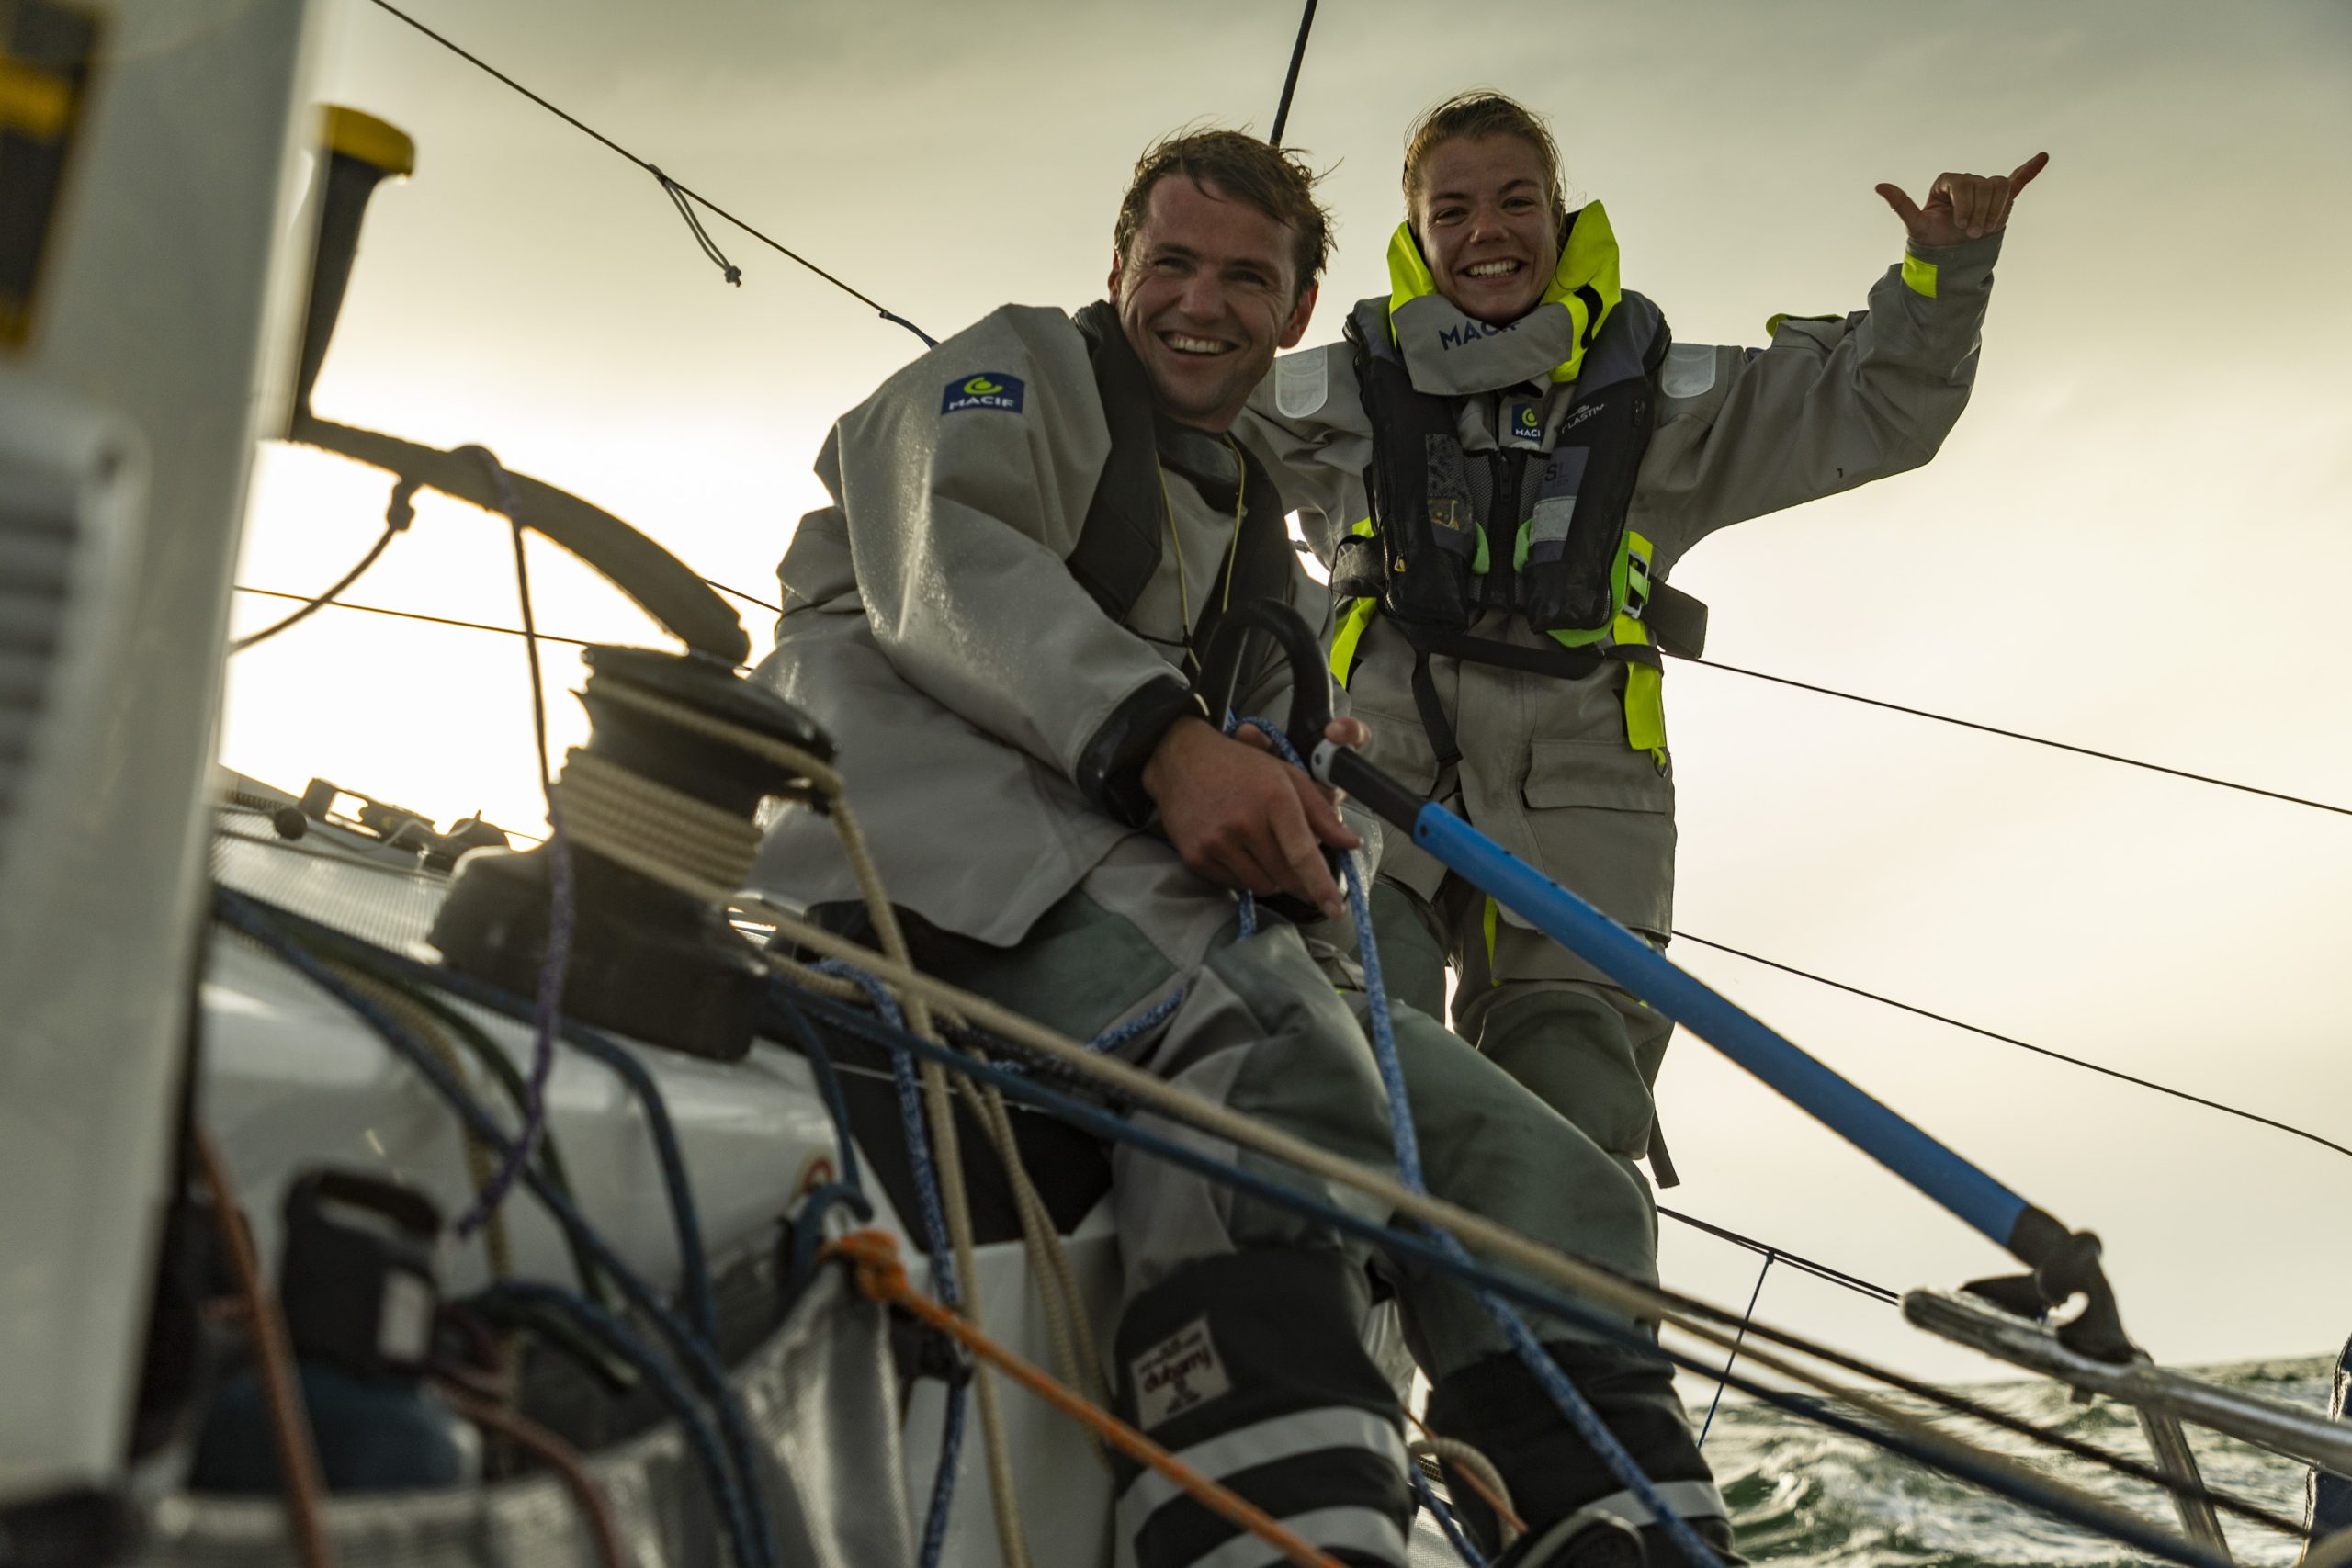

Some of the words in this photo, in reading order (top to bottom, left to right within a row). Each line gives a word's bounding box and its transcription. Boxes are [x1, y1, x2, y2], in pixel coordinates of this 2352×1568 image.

[1438, 320, 1521, 351] MAC
[948, 396, 1014, 411] MACIF
[1515, 428, 1541, 438] MACI
